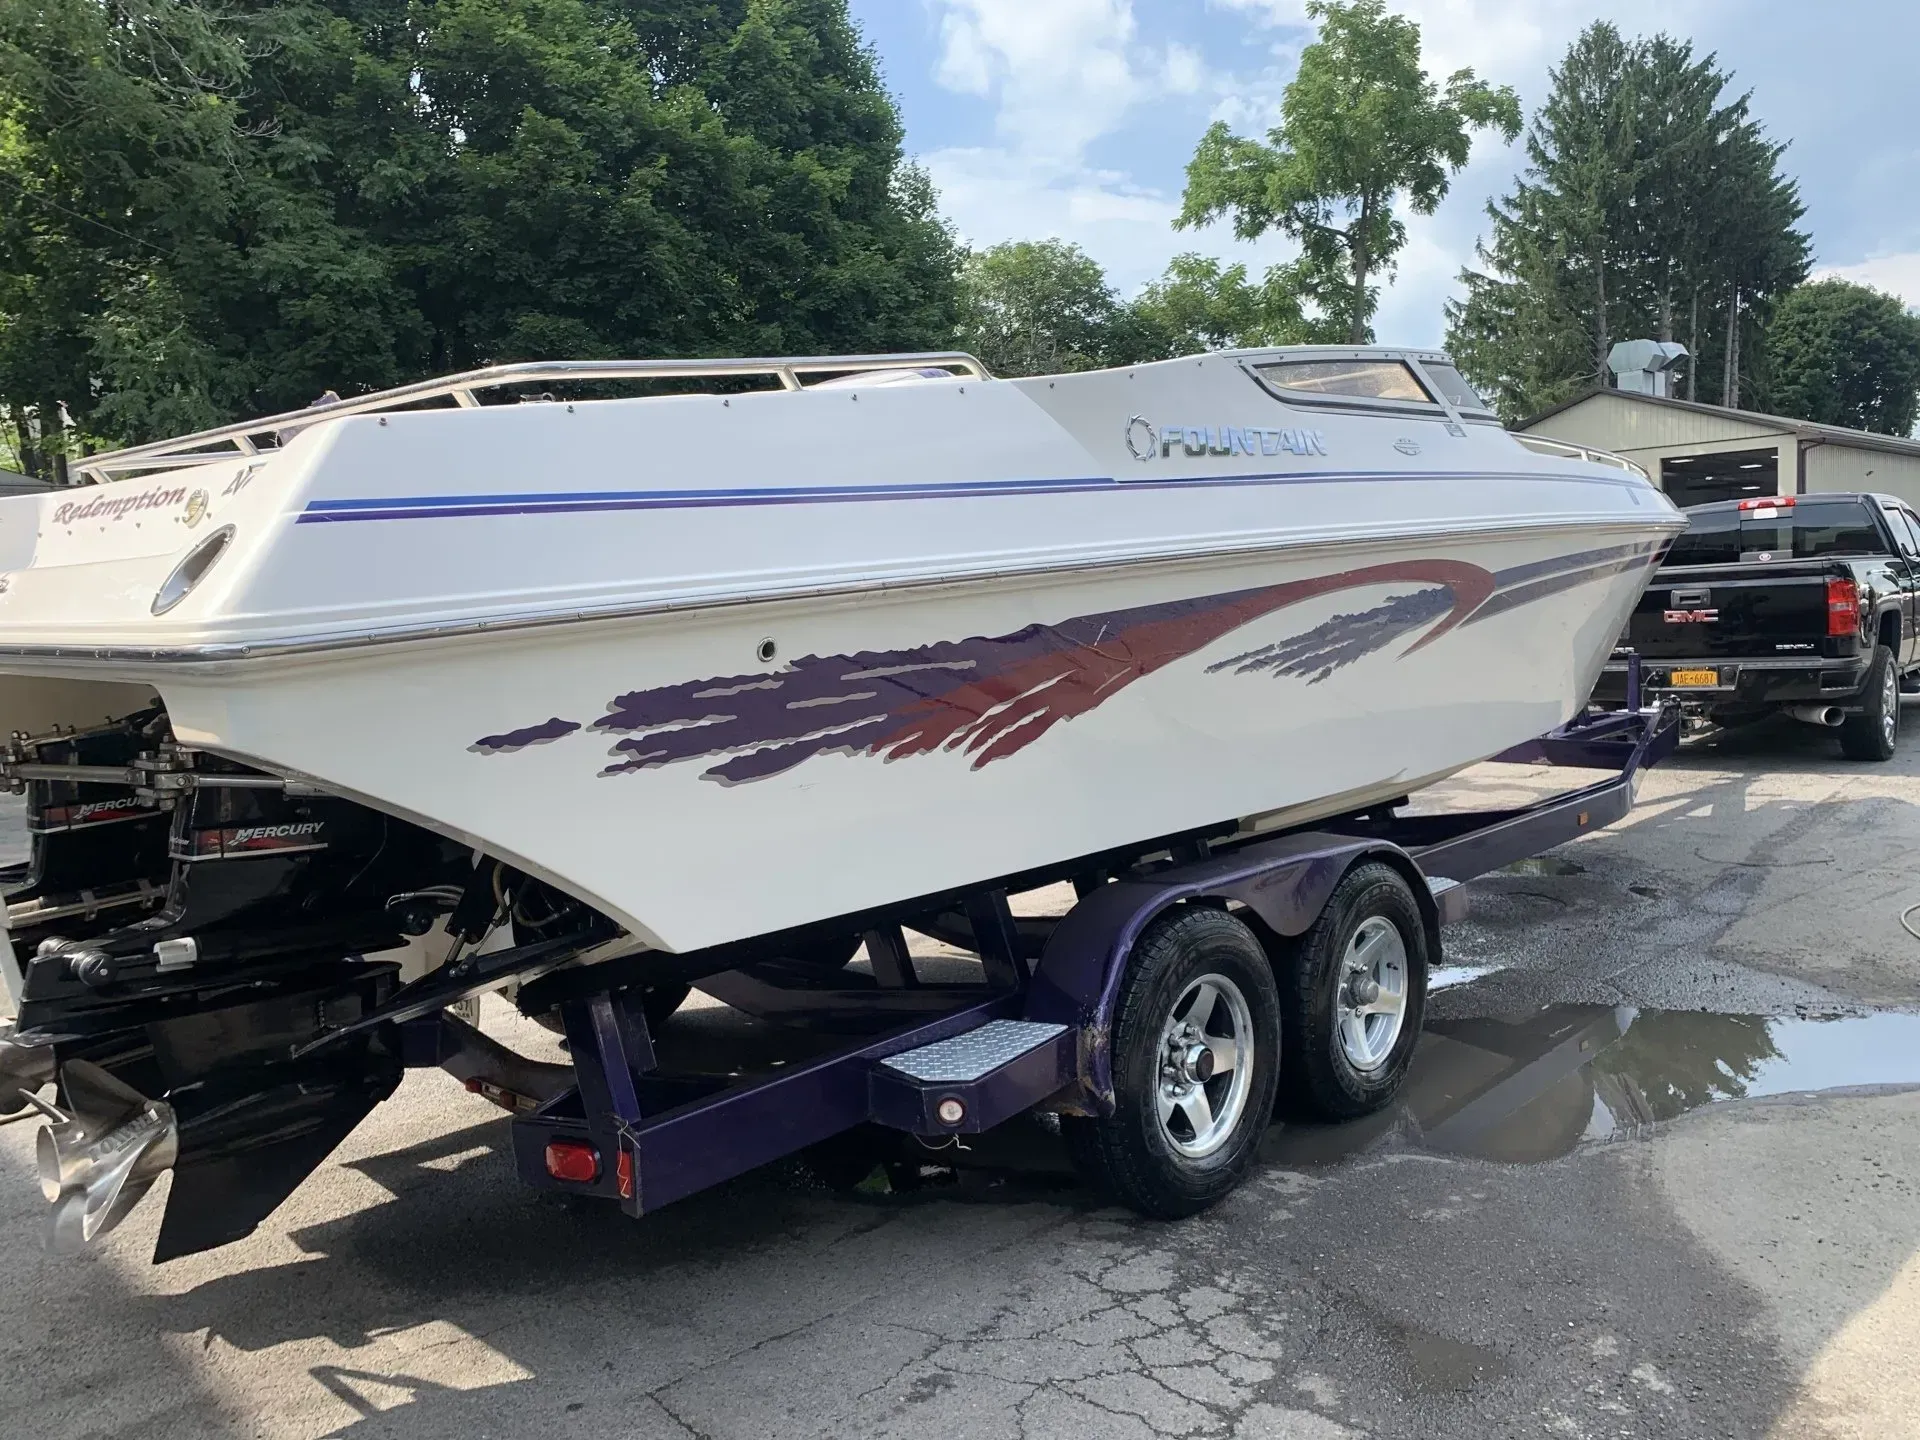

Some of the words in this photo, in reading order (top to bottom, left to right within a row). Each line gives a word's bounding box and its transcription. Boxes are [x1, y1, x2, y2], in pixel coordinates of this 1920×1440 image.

[1159, 426, 1328, 458] FOUNTAIN
[52, 486, 187, 524] Redemption
[1663, 608, 1719, 623] GMC
[73, 796, 144, 820] MERCU
[227, 821, 325, 847] MERCURY
